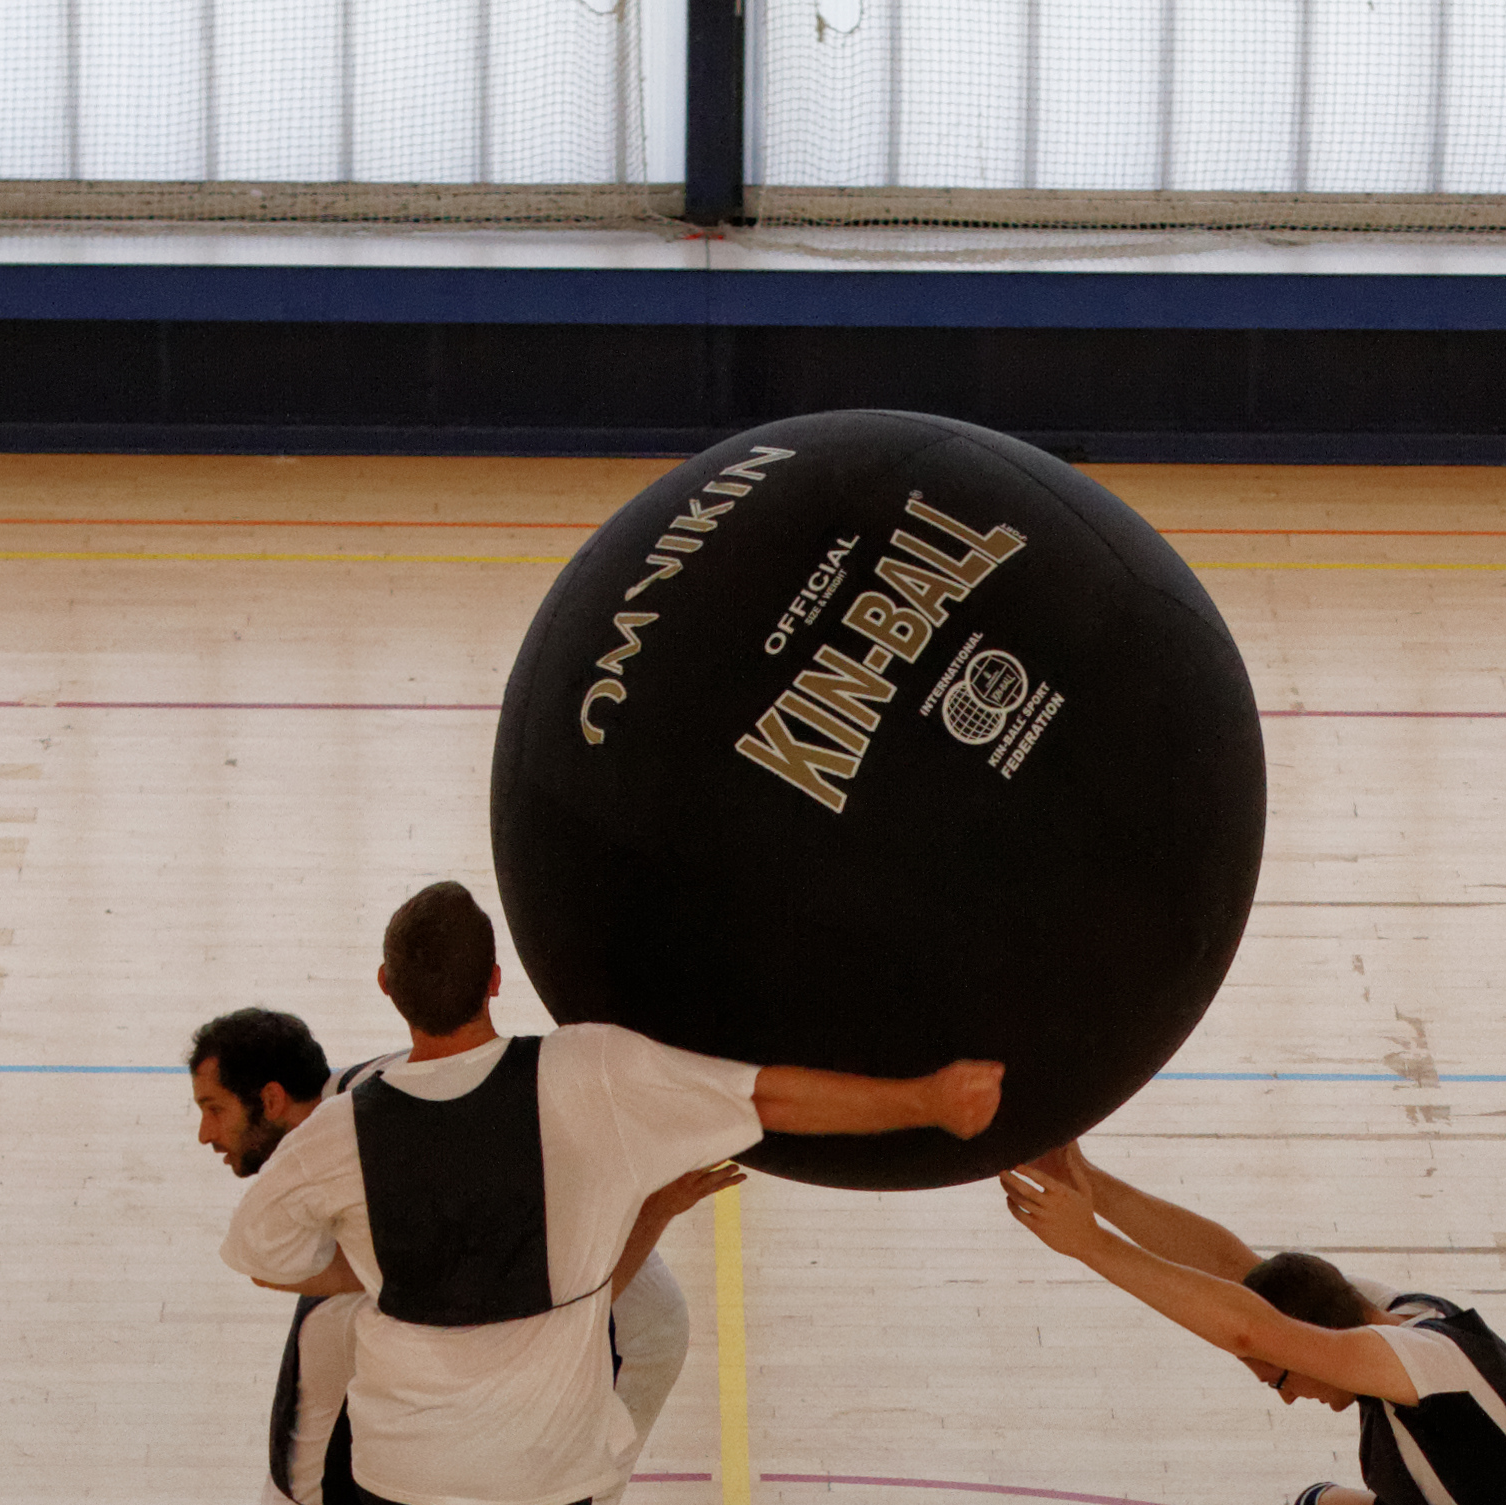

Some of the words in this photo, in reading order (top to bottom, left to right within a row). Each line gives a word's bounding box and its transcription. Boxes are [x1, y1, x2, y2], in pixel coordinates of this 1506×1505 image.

[764, 535, 860, 655] OFFICIAL
[804, 605, 822, 626] SIZE
[822, 569, 847, 599] WEIGHT
[734, 499, 1027, 814] KIN-BALL
[919, 631, 984, 717] INTERNATIONAL
[987, 715, 1027, 768] KIN-BALL
[1022, 680, 1051, 718] SPORT
[1000, 692, 1065, 780] FEDERATION
